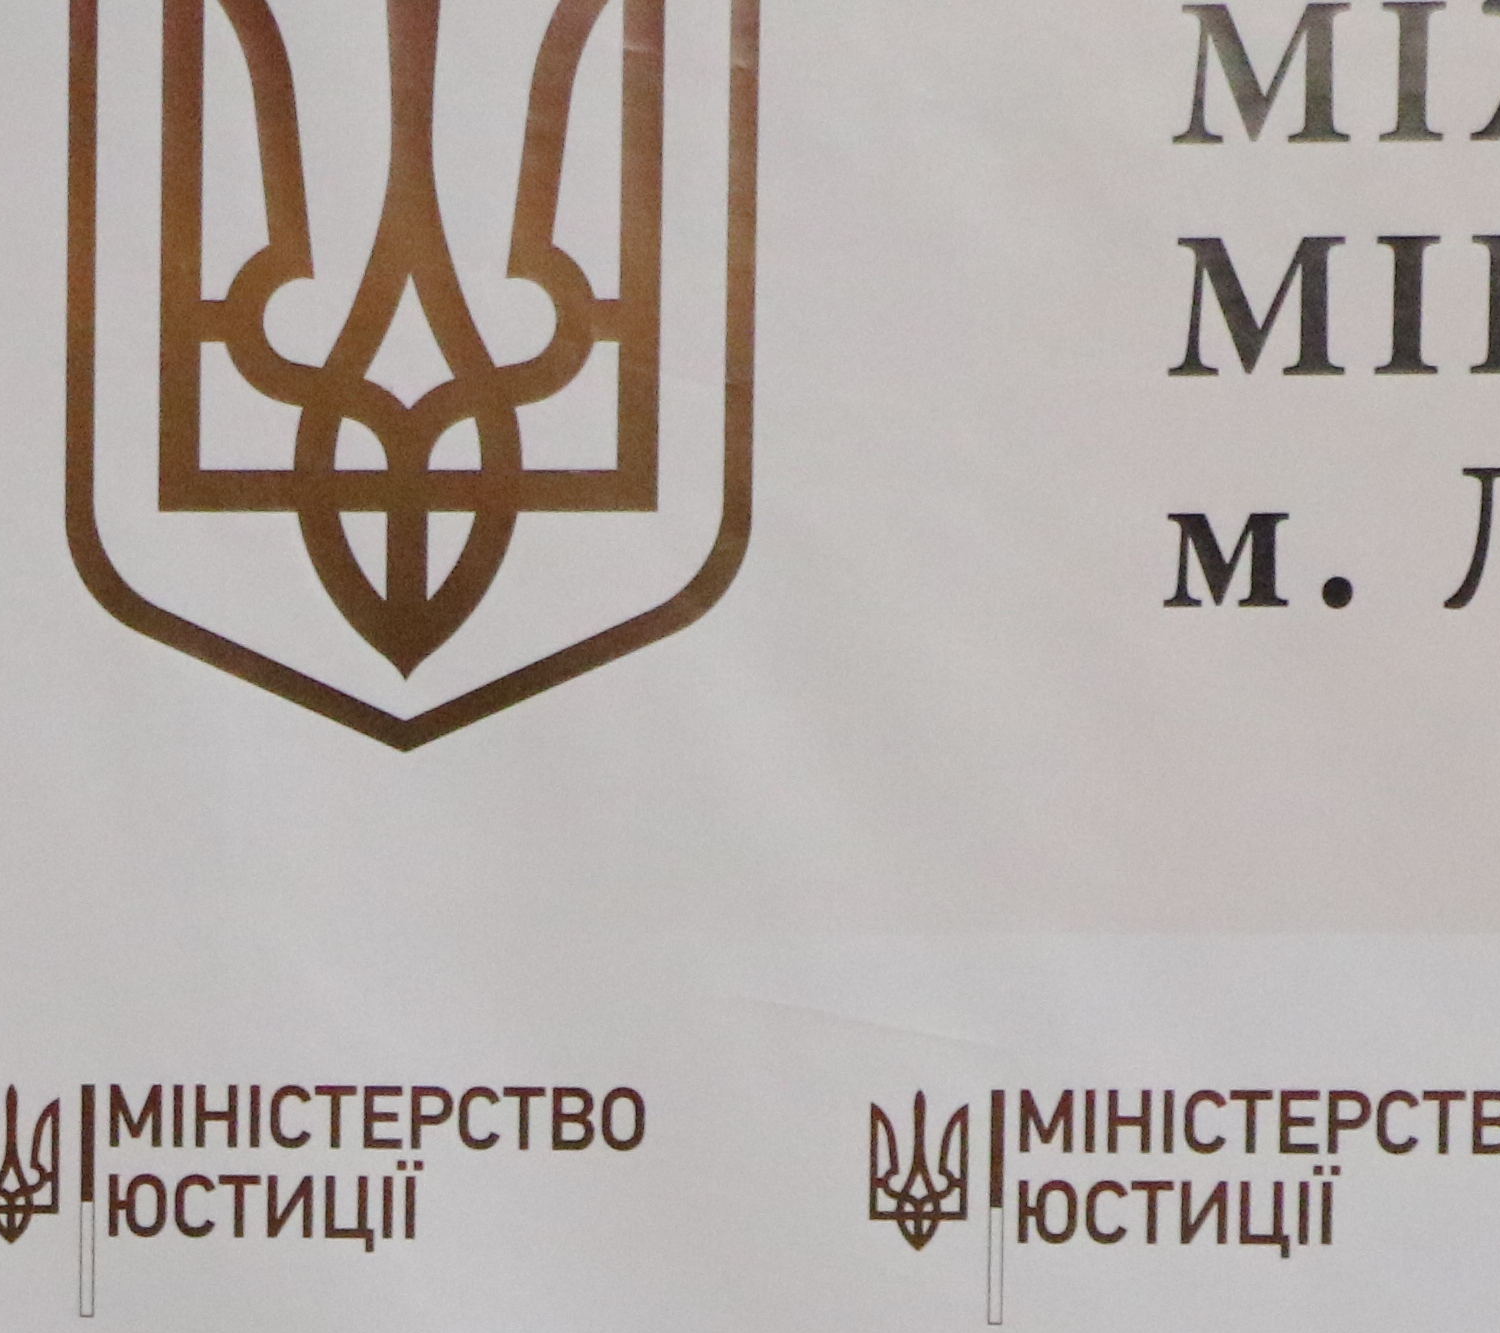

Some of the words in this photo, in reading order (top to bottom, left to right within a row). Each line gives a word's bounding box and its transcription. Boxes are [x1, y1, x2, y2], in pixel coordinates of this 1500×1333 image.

[1163, 512, 1354, 610] м.
[108, 1083, 646, 1152] МІНІСТЕРСТВО
[107, 1159, 424, 1253] ЮСТИЦІЇ
[1017, 1164, 1341, 1259] ЮСТИЦІЇ
